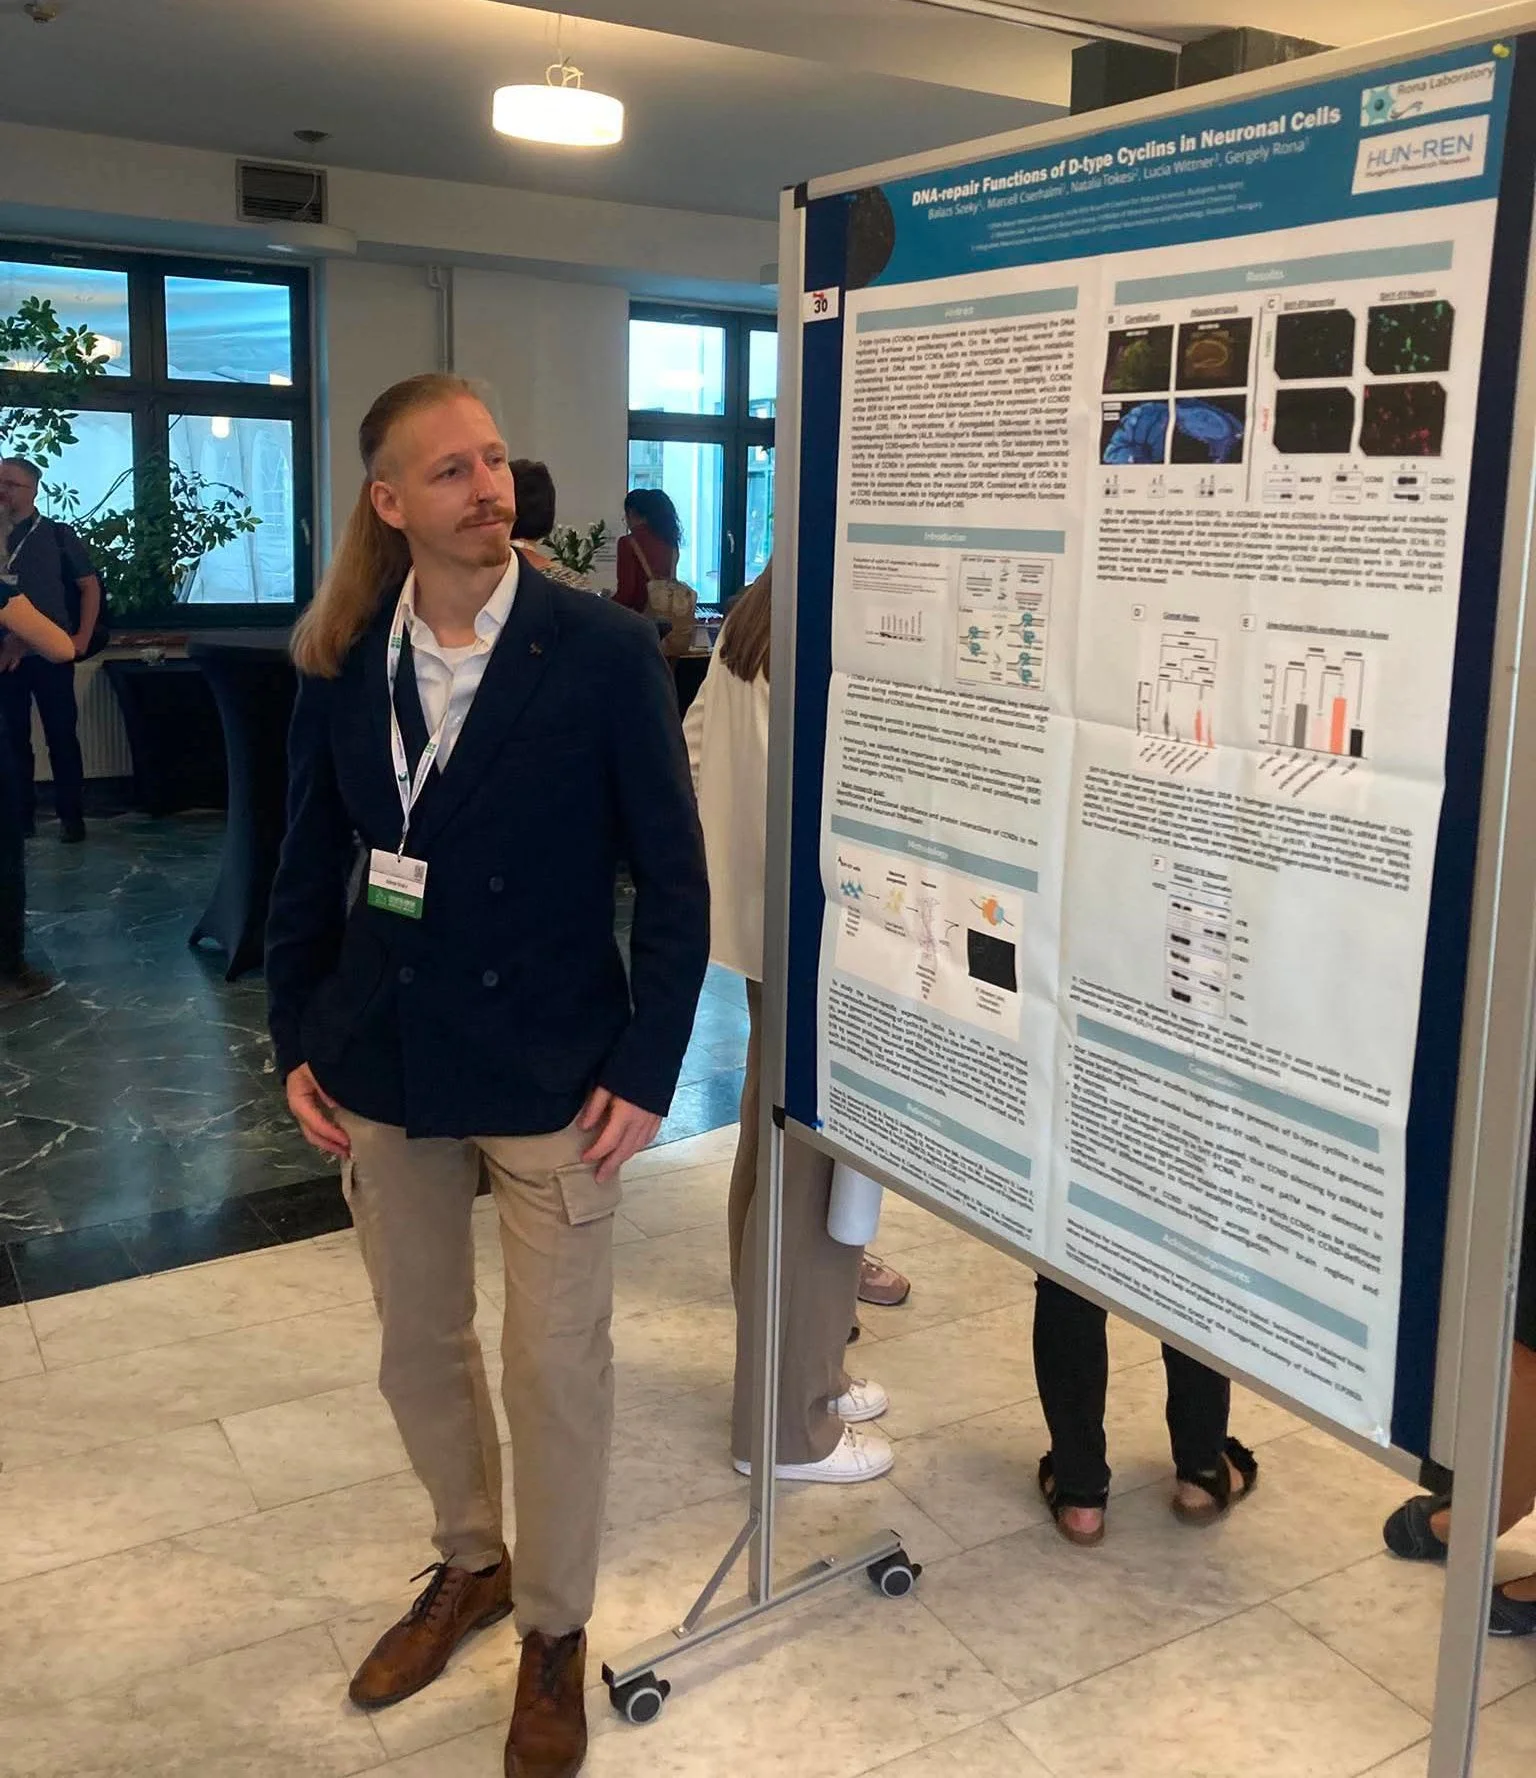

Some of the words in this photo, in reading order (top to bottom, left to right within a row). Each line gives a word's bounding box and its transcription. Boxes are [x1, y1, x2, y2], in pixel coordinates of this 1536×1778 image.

[1429, 66, 1495, 90] Laboratory
[912, 181, 979, 206] DNA-repair
[983, 168, 1047, 193] Functions
[1051, 160, 1066, 178] of
[1069, 153, 1113, 177] D-type
[1117, 140, 1176, 166] Cyclins
[1180, 135, 1196, 152] in
[1201, 115, 1286, 148] Neuronal
[1291, 106, 1341, 131] Cells
[1366, 133, 1473, 169] HUN-REN
[814, 298, 828, 314] 30
